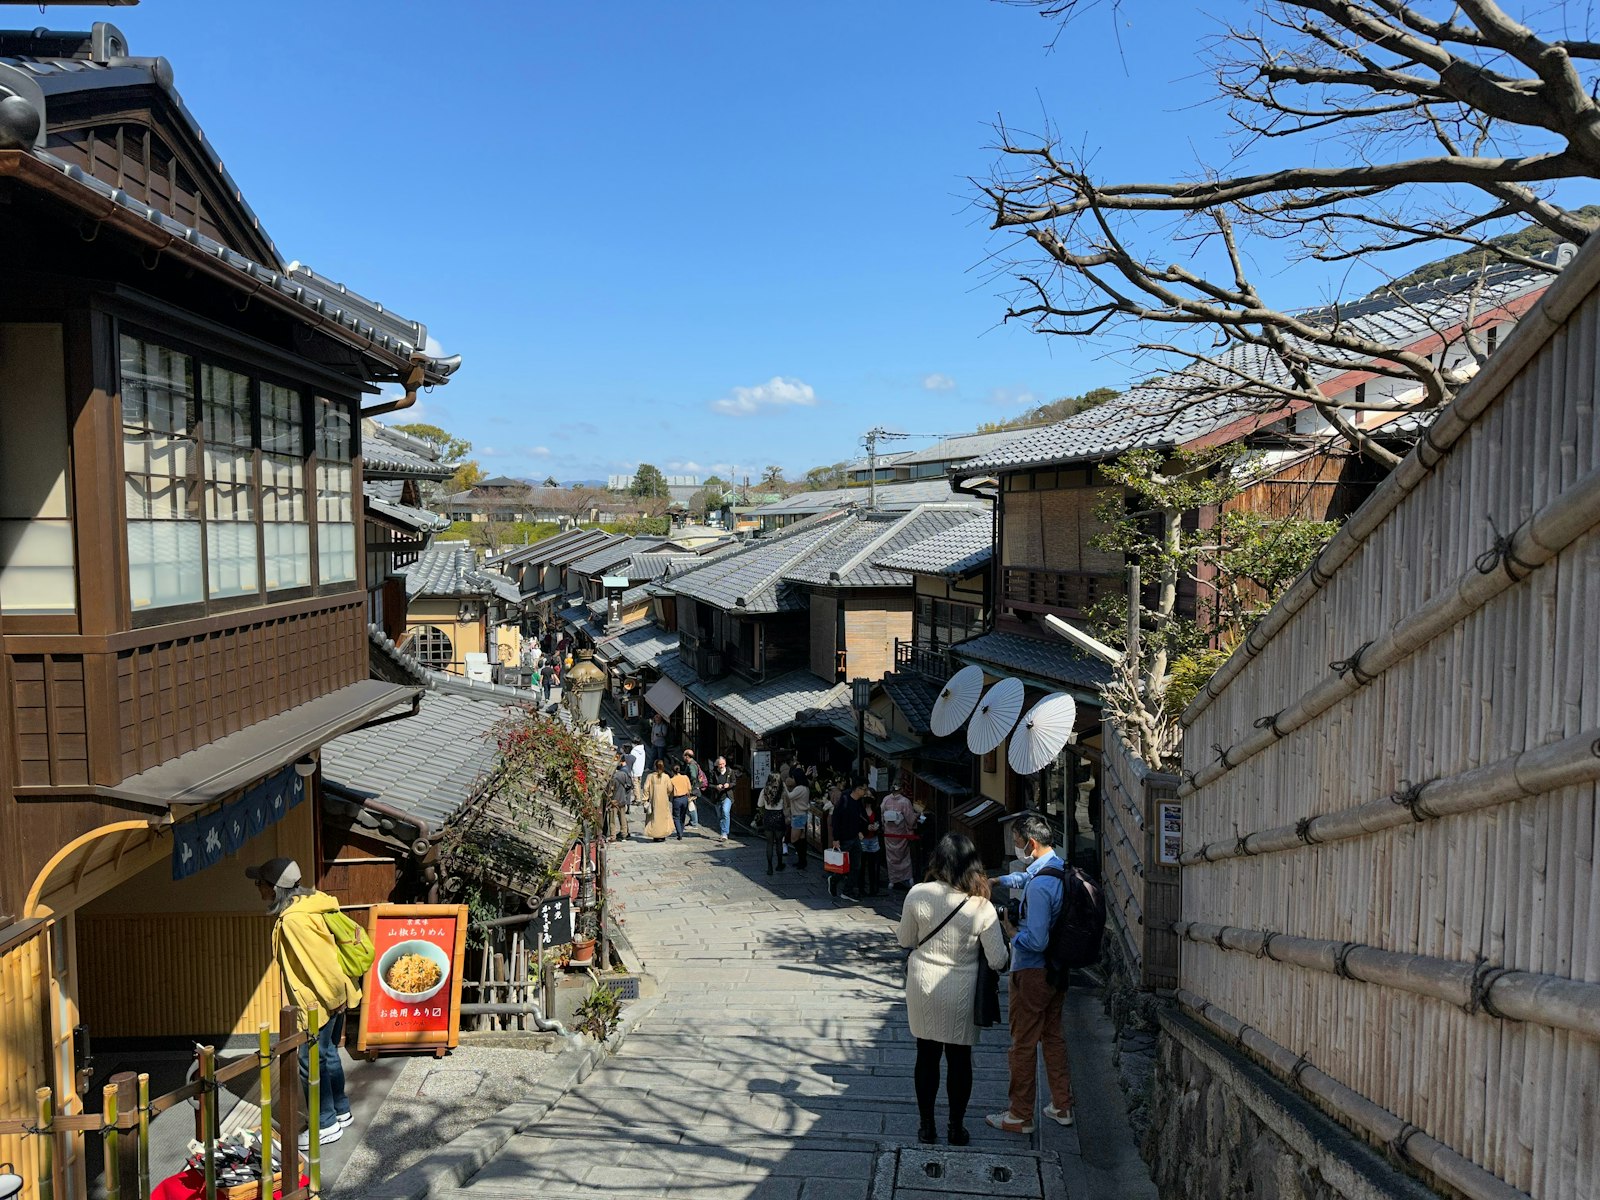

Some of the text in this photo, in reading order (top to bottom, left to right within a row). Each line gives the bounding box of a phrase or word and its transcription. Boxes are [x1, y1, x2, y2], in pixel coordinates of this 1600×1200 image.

[388, 927, 446, 937] 山椒ちりめん
[380, 1008, 409, 1018] お徳用
